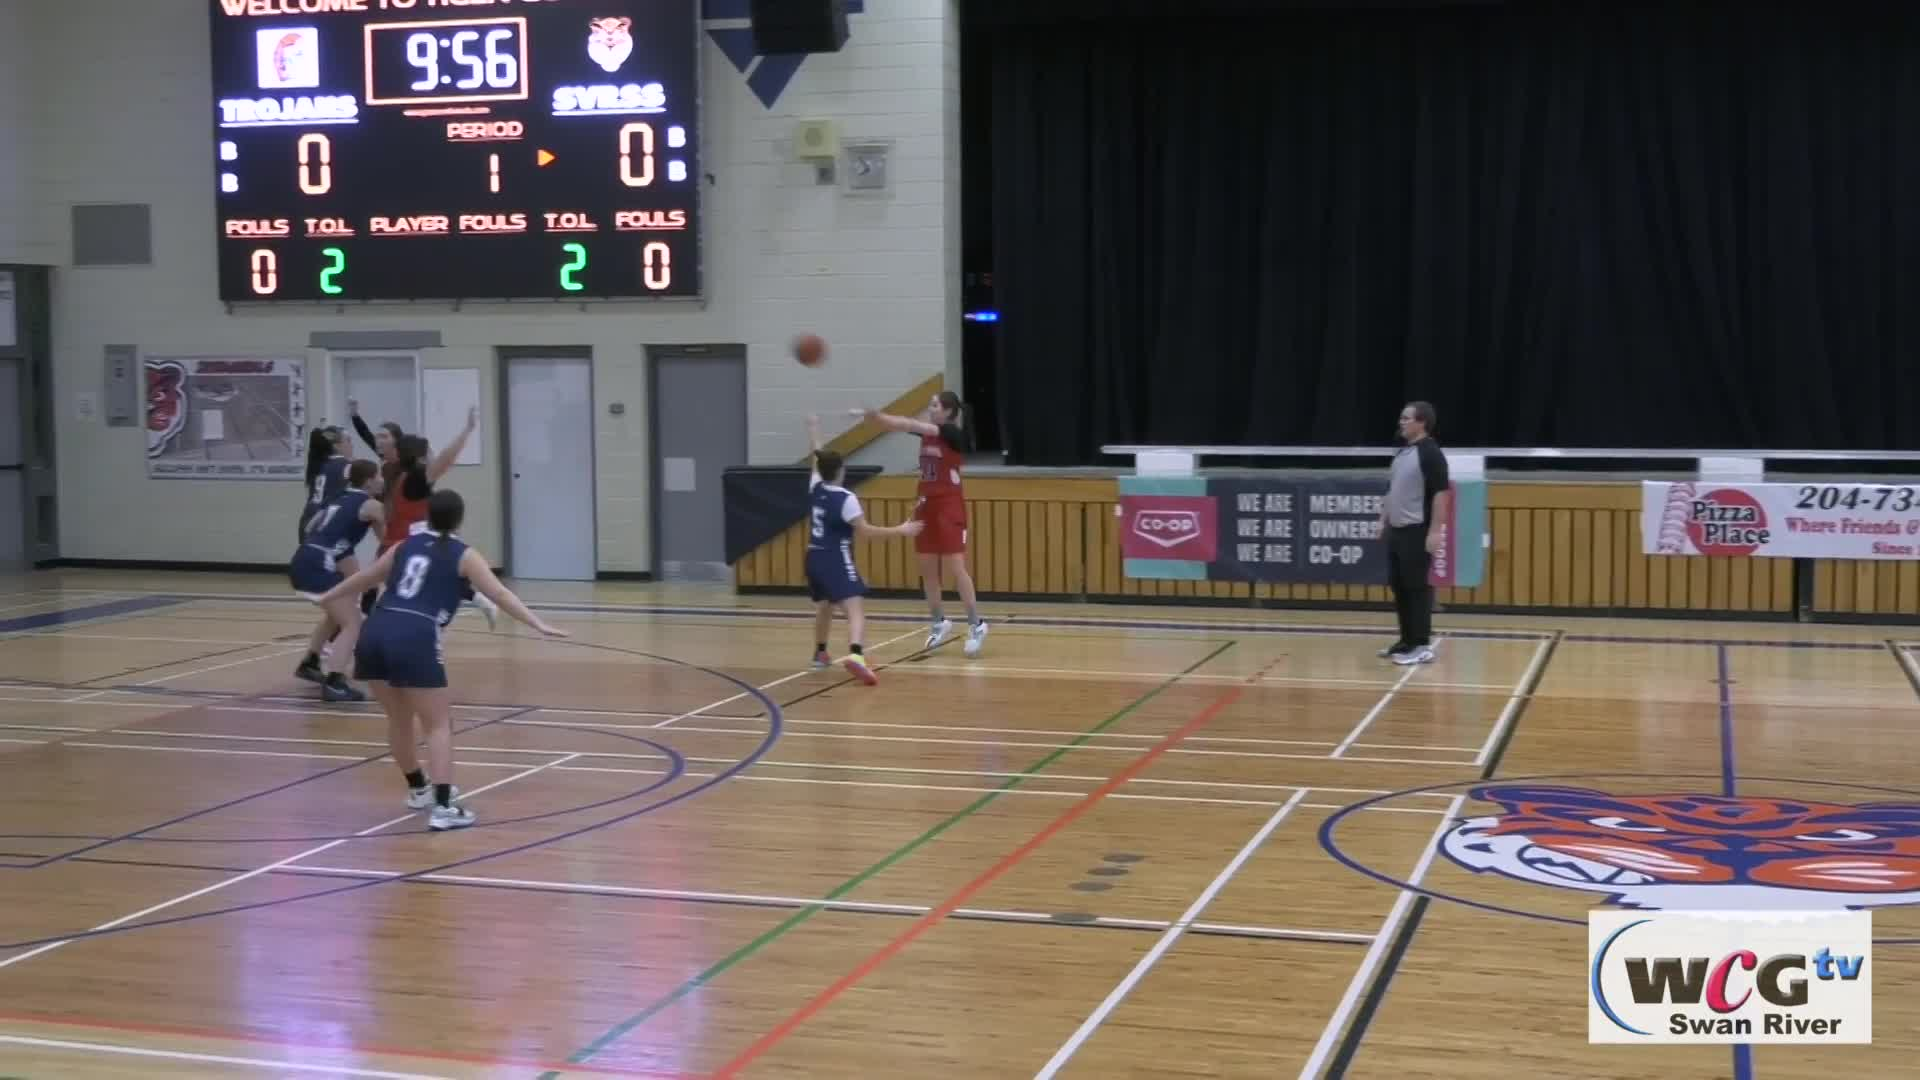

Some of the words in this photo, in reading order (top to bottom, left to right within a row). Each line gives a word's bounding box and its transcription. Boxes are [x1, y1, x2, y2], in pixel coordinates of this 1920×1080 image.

[406, 29, 518, 91] 9:56
[447, 121, 523, 138] PERIOD
[667, 126, 687, 148] B
[220, 141, 238, 160] B
[619, 122, 655, 187] 0
[298, 133, 330, 195] 0
[489, 153, 500, 193] 1
[668, 160, 688, 181] B
[221, 173, 239, 192] B
[225, 219, 290, 235] FOULS
[369, 215, 449, 233] PLAYER
[459, 213, 527, 230] FOULS
[615, 210, 686, 227] FOULS
[251, 249, 277, 294] 0
[320, 247, 345, 294] 2
[560, 243, 586, 291] 2
[643, 242, 671, 290] 0
[1264, 493, 1293, 512] ARE
[1691, 499, 1756, 523] Pizza
[812, 506, 825, 538] 5
[1140, 519, 1192, 531] CO-OP
[1264, 519, 1293, 538] ARE
[1704, 523, 1771, 544] Place
[1309, 545, 1363, 564] CO-OP
[397, 555, 430, 600] 8
